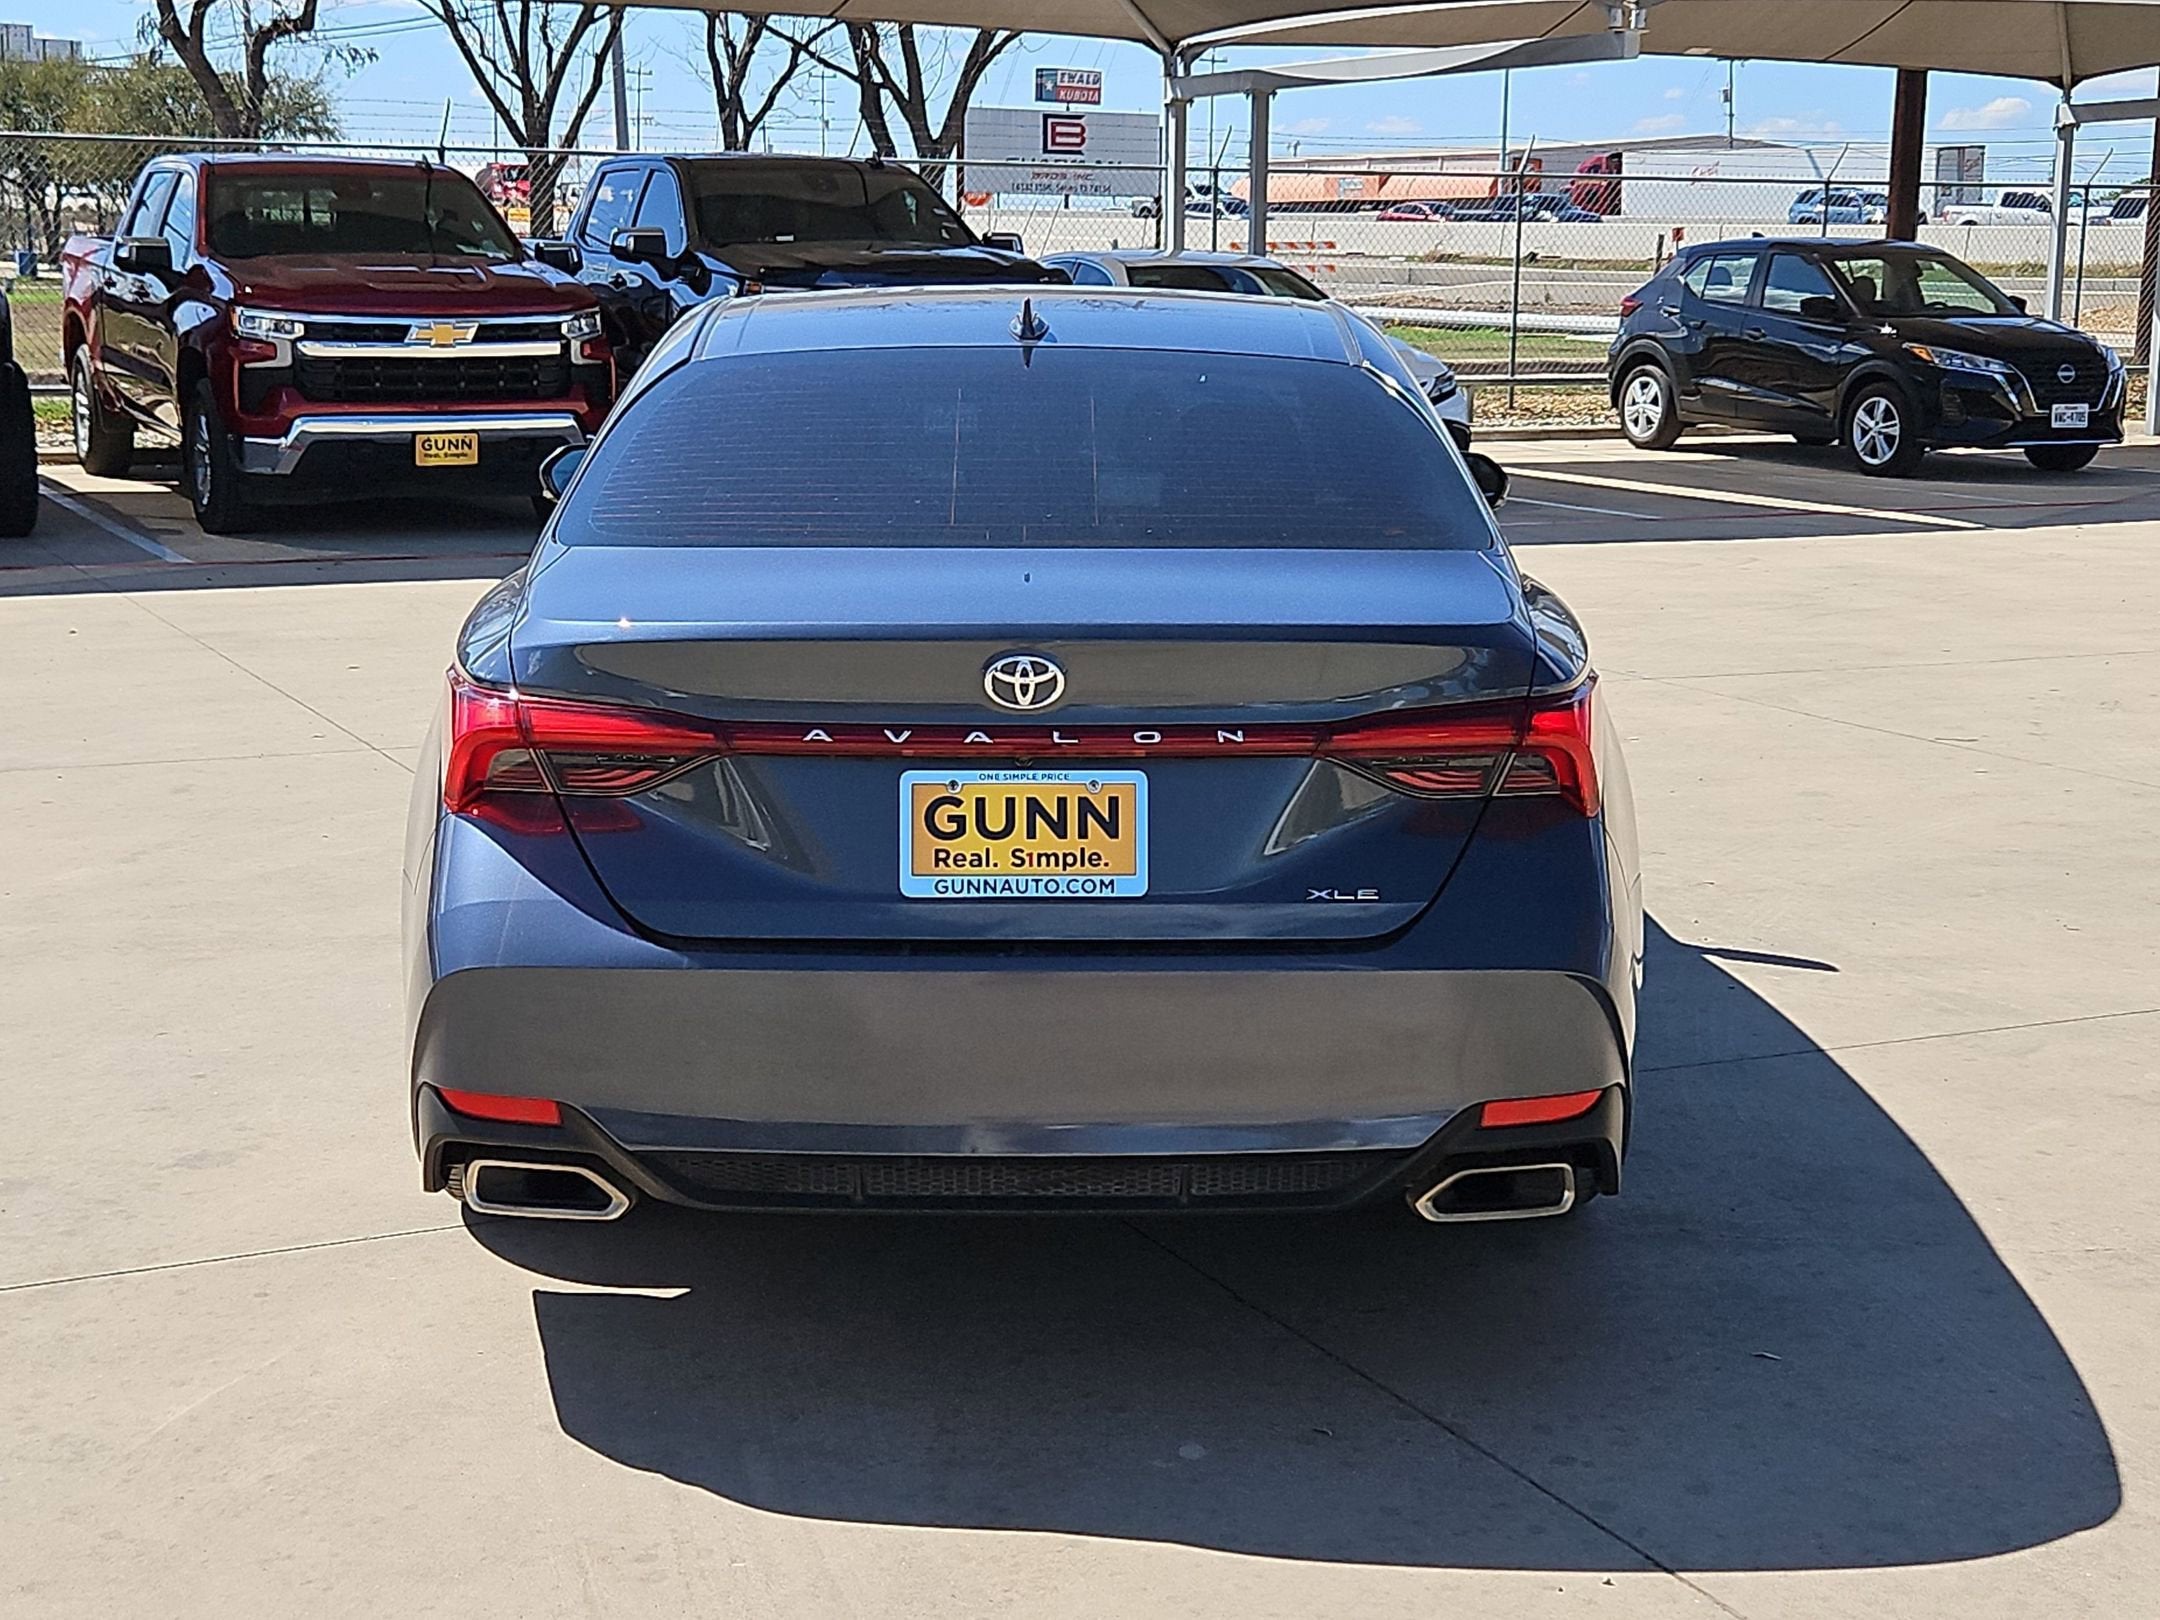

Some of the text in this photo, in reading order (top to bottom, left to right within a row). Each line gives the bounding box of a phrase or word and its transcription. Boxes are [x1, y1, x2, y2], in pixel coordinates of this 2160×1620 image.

[1059, 72, 1100, 85] EWALD
[1058, 89, 1099, 102] KUBOTA
[421, 437, 473, 451] GUNN
[803, 729, 1244, 744] AVALON
[979, 773, 1070, 781] ONE SIMPLE PRICE
[924, 795, 1120, 840] GUNN
[934, 847, 999, 868] Real.
[934, 878, 1116, 894] GUNNAUTO.COM
[1306, 889, 1379, 900] XLE
